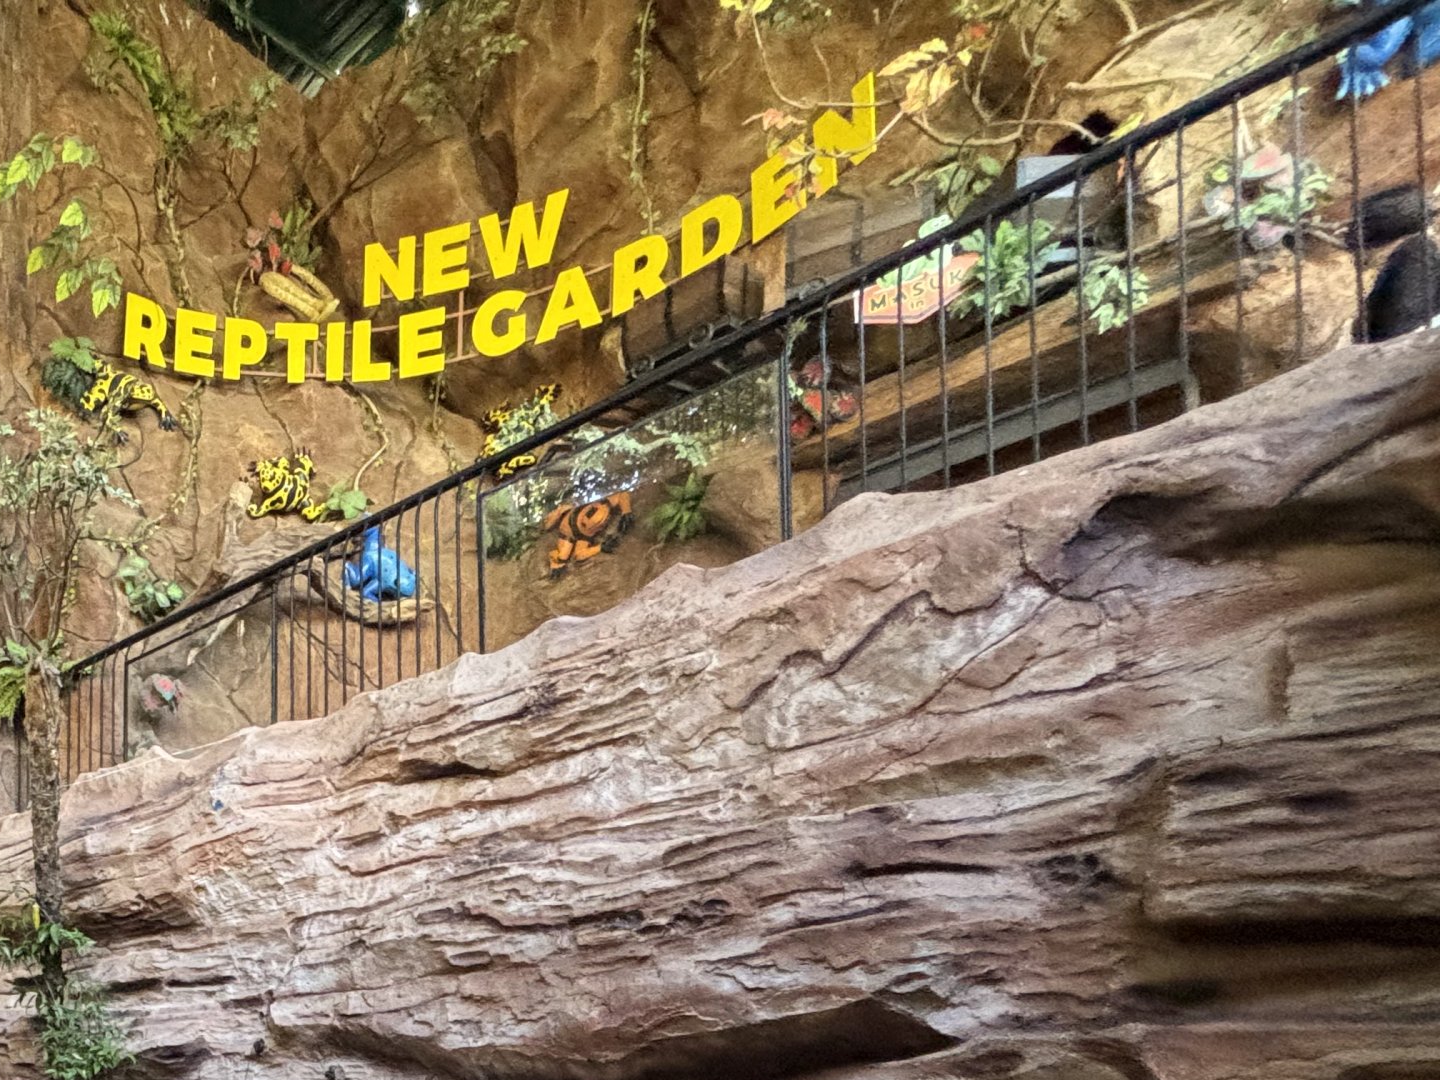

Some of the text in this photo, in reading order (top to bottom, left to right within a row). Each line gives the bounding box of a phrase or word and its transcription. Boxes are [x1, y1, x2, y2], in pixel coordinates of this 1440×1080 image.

[124, 70, 877, 383] REPTILE GARDEN
[363, 188, 569, 307] NEW
[870, 268, 964, 312] MASUK
